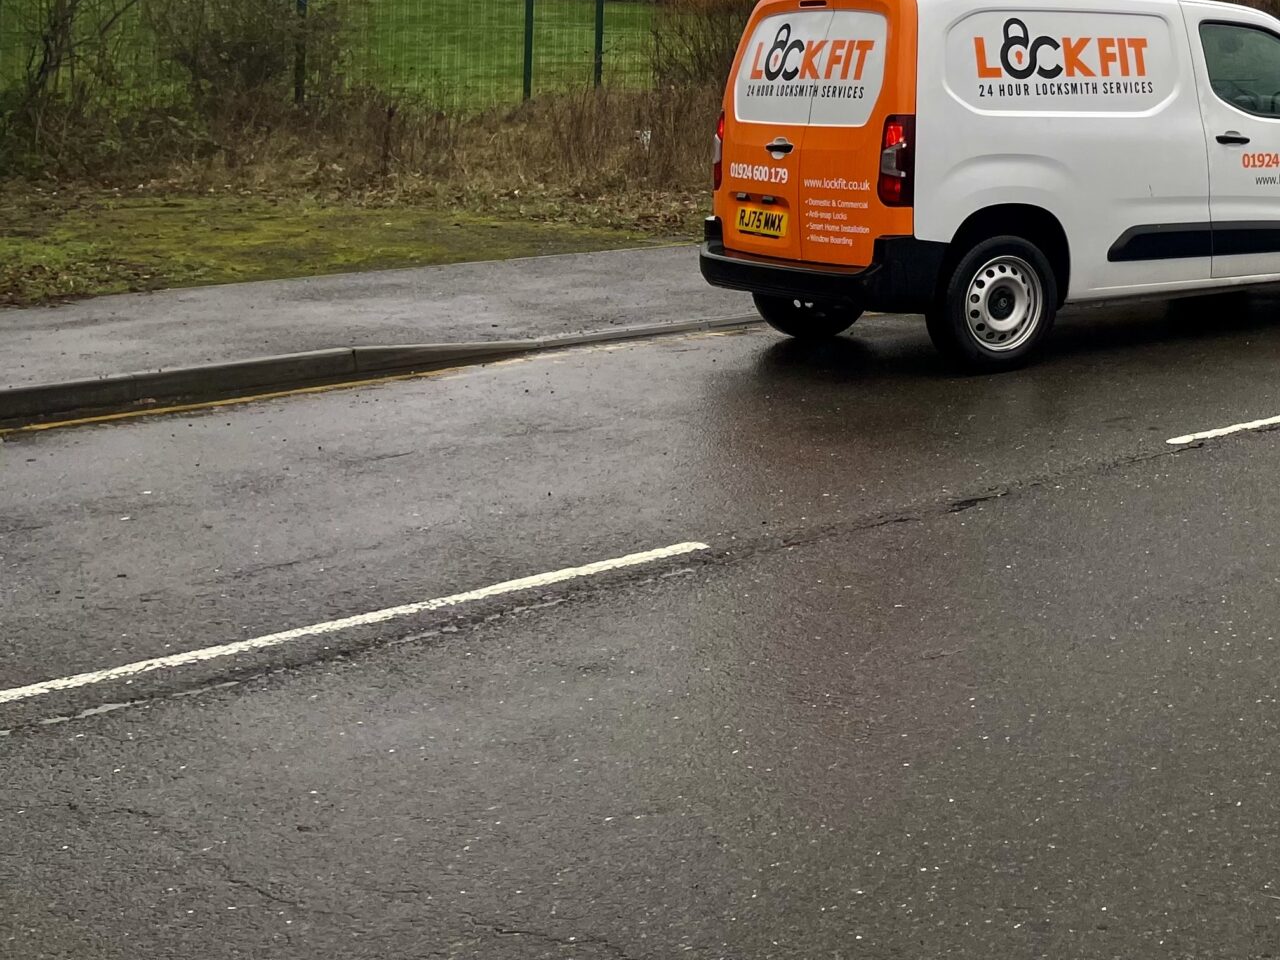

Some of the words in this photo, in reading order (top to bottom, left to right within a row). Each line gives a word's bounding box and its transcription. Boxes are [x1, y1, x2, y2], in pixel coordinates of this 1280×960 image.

[746, 84, 755, 97] 24
[755, 84, 774, 97] HOUR
[775, 84, 819, 98] LOCKSMITH
[821, 85, 865, 100] SERVICES
[978, 84, 994, 98] 24
[999, 83, 1030, 97] HOUR
[1035, 82, 1098, 97] LOCKSMITH
[1102, 81, 1154, 96] SERVICES
[1242, 153, 1280, 168] 01924
[730, 162, 753, 180] 01924
[753, 165, 769, 182] 600
[770, 167, 788, 184] 179
[803, 177, 871, 191] www.lockfit.co.uk
[808, 198, 831, 207] Domestic
[837, 200, 869, 209] Commercial
[739, 208, 763, 229] RJ75
[832, 212, 848, 220] Locks
[824, 223, 840, 232] Home
